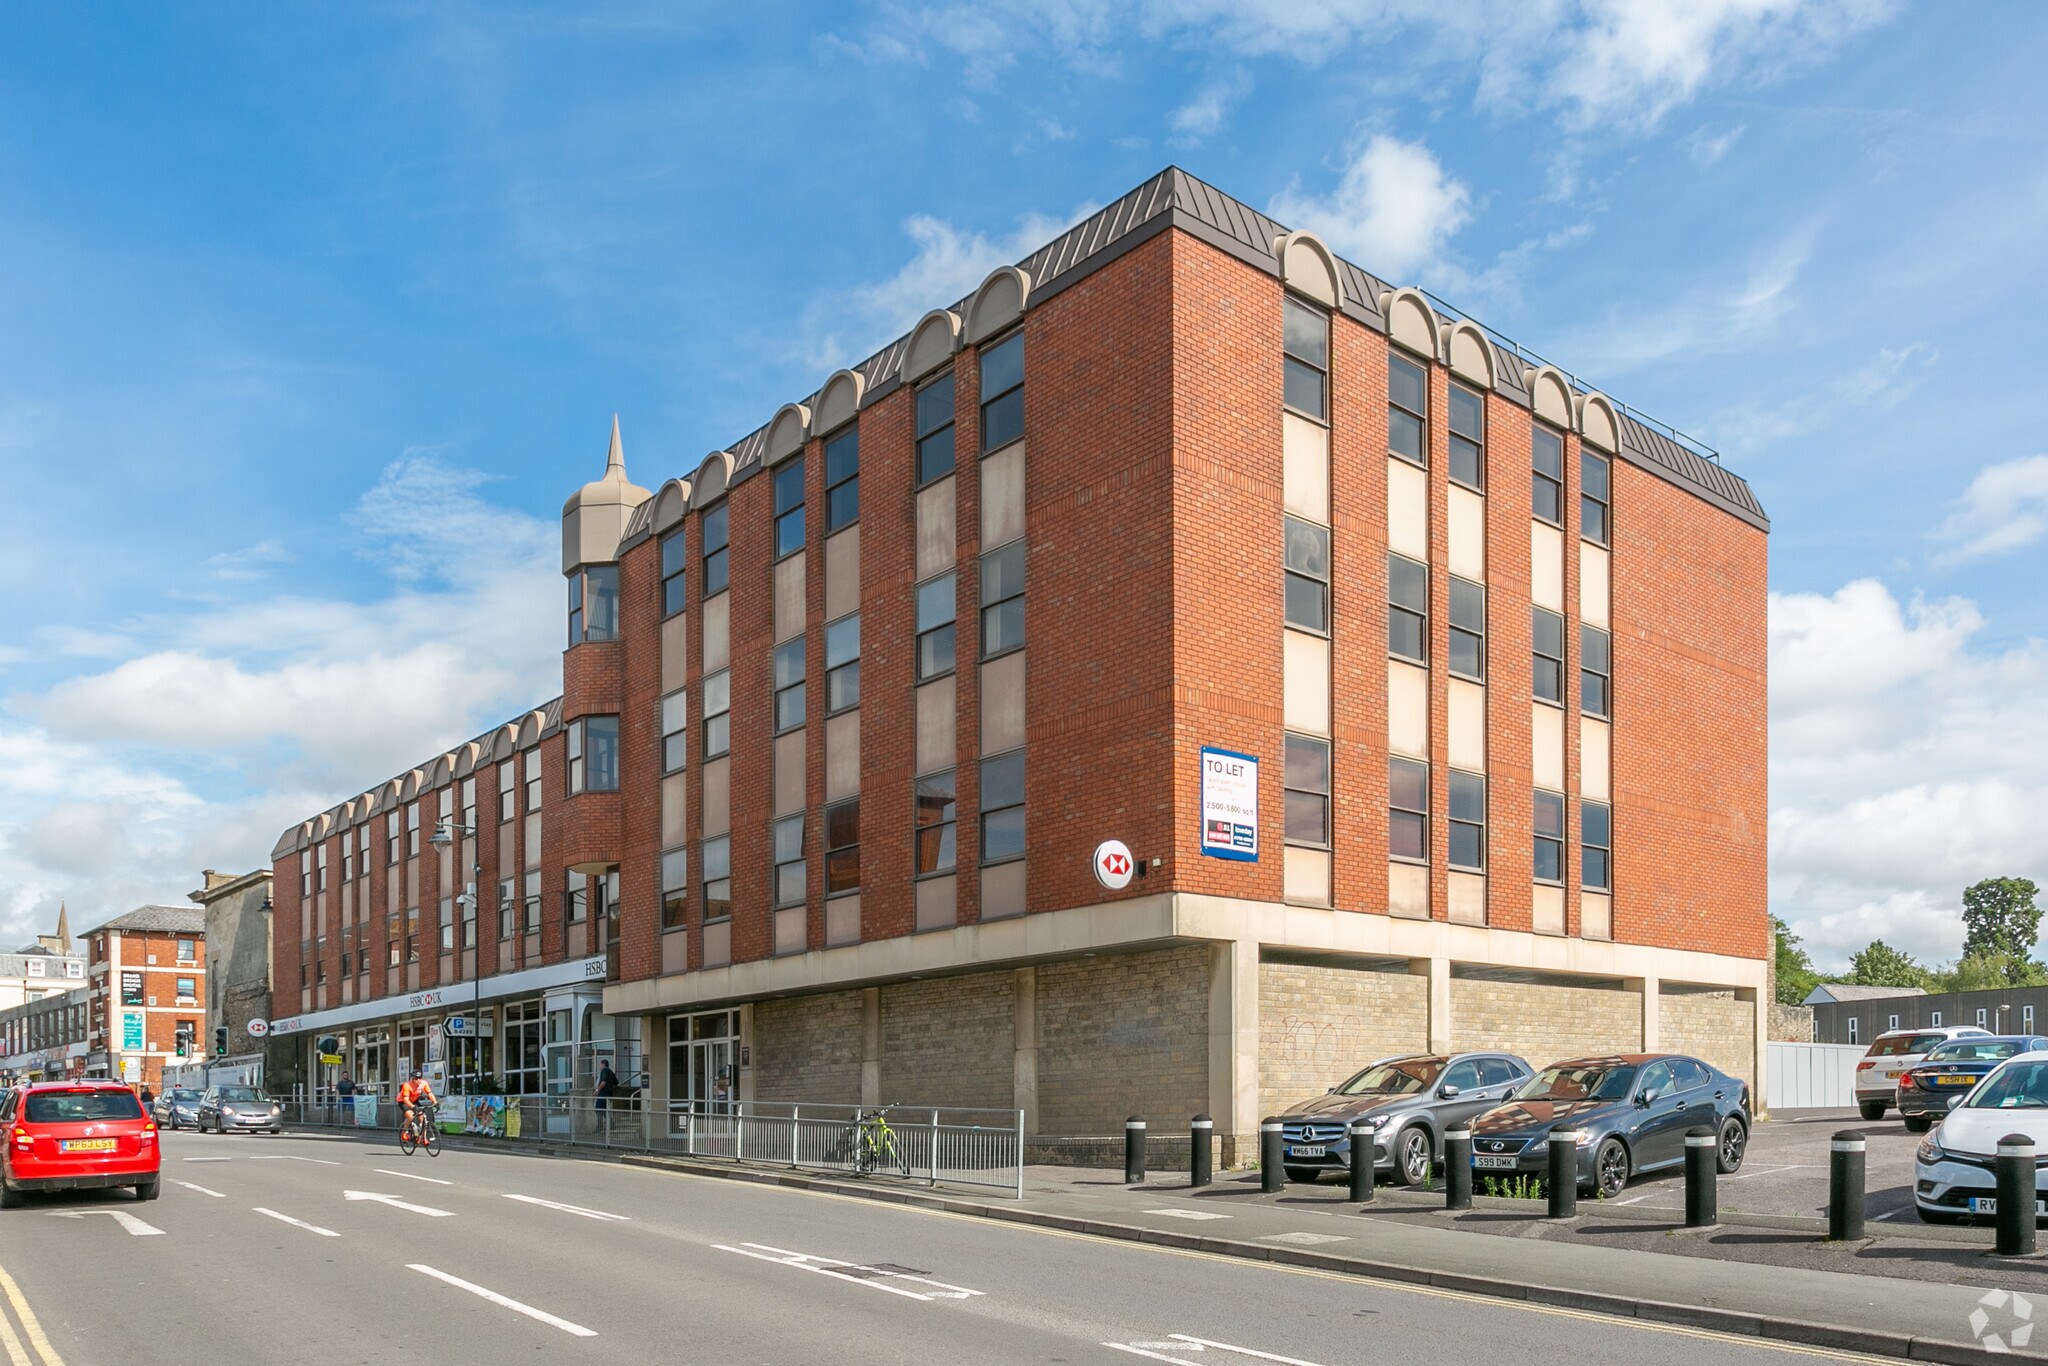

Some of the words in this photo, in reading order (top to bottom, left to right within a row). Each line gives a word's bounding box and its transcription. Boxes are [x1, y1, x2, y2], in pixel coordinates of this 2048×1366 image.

[1207, 760, 1223, 774] TO
[1226, 763, 1245, 777] LET
[585, 959, 607, 977] HSBC
[410, 995, 425, 1009] HSBC
[433, 991, 443, 1004] UK
[1310, 1147, 1324, 1155] TVA
[1478, 1157, 1495, 1167] S99
[1496, 1158, 1513, 1167] DMK
[1980, 1199, 1997, 1211] RV
